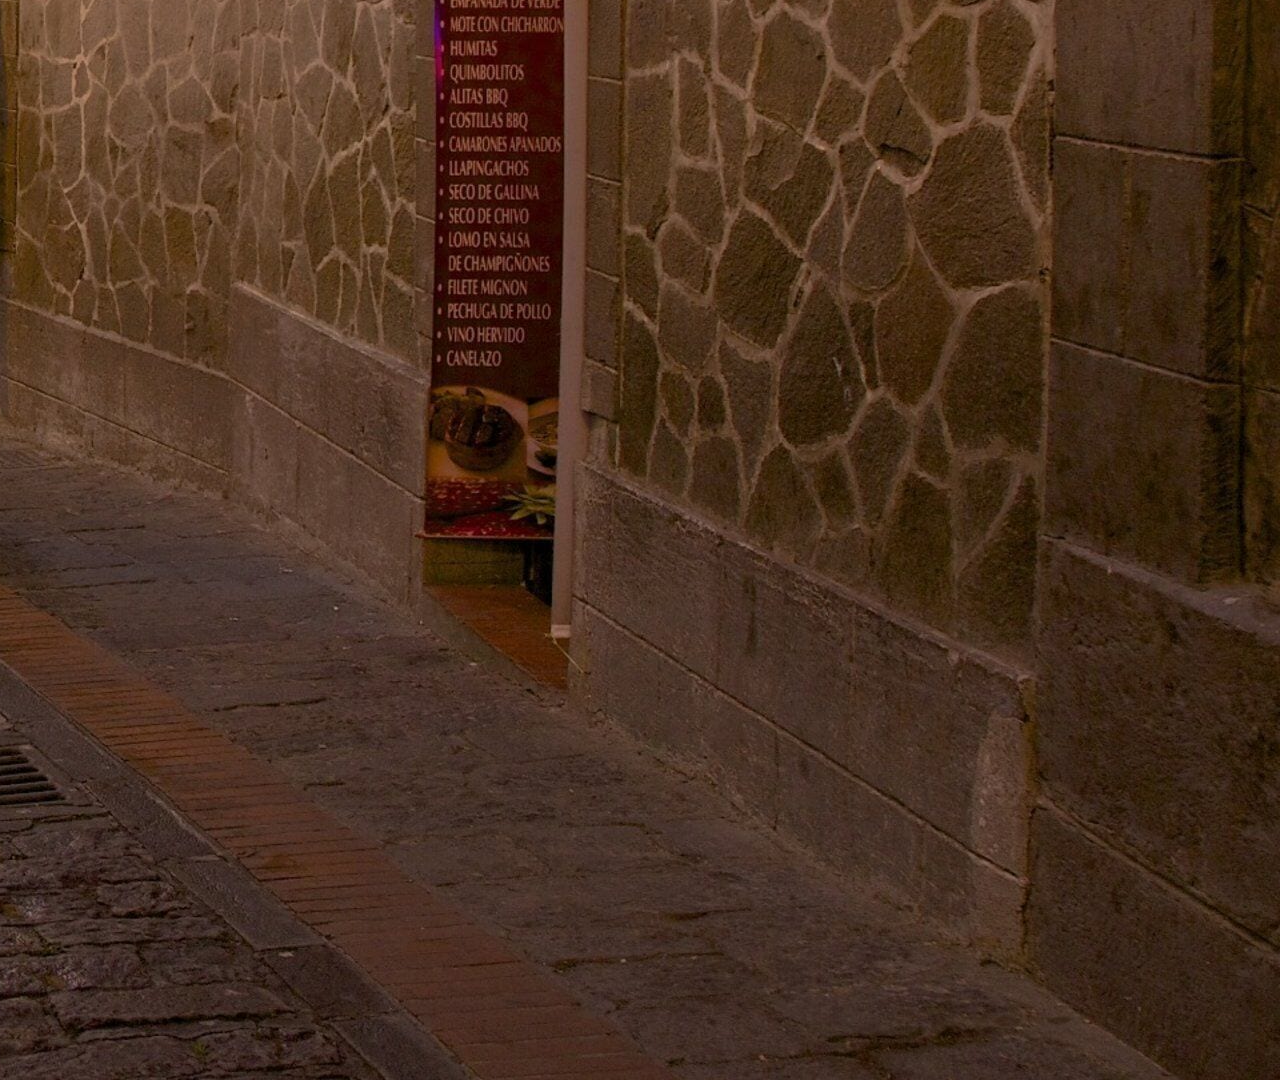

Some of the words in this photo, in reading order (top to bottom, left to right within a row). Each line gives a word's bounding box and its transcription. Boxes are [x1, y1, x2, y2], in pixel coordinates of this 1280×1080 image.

[450, 16, 476, 33] MOTE
[476, 16, 499, 33] CON
[500, 16, 564, 33] CHICHARRON
[450, 40, 498, 57] HUMITAS
[450, 64, 525, 84] QUIMBOLITOS
[449, 88, 483, 104] ALITAS
[486, 88, 509, 108] BBQ
[449, 112, 503, 129] COSTILLAS
[506, 112, 529, 131] BBQ
[449, 136, 507, 152] CAMARONES
[509, 136, 562, 152] APANADOS
[449, 160, 529, 177] LLAPINGACHOS
[449, 184, 476, 200] SECO
[478, 184, 492, 200] DE
[494, 184, 540, 200] GALLINA
[449, 208, 476, 224] SECO
[478, 208, 492, 224] DE
[493, 208, 529, 224] CHIVO
[448, 231, 481, 248] LOMO
[483, 231, 497, 248] EN
[499, 231, 530, 248] SALSA
[448, 256, 462, 272] DE
[463, 252, 550, 272] CHAMPIGÑONES
[448, 279, 478, 295] FILETE
[481, 279, 528, 295] MIGNON
[447, 303, 497, 320] PECHUGA
[500, 303, 514, 320] DE
[517, 303, 551, 320] POLLO
[447, 327, 476, 343] VINO
[477, 327, 525, 343] HERVIDO
[446, 350, 502, 367] CANELAZO
